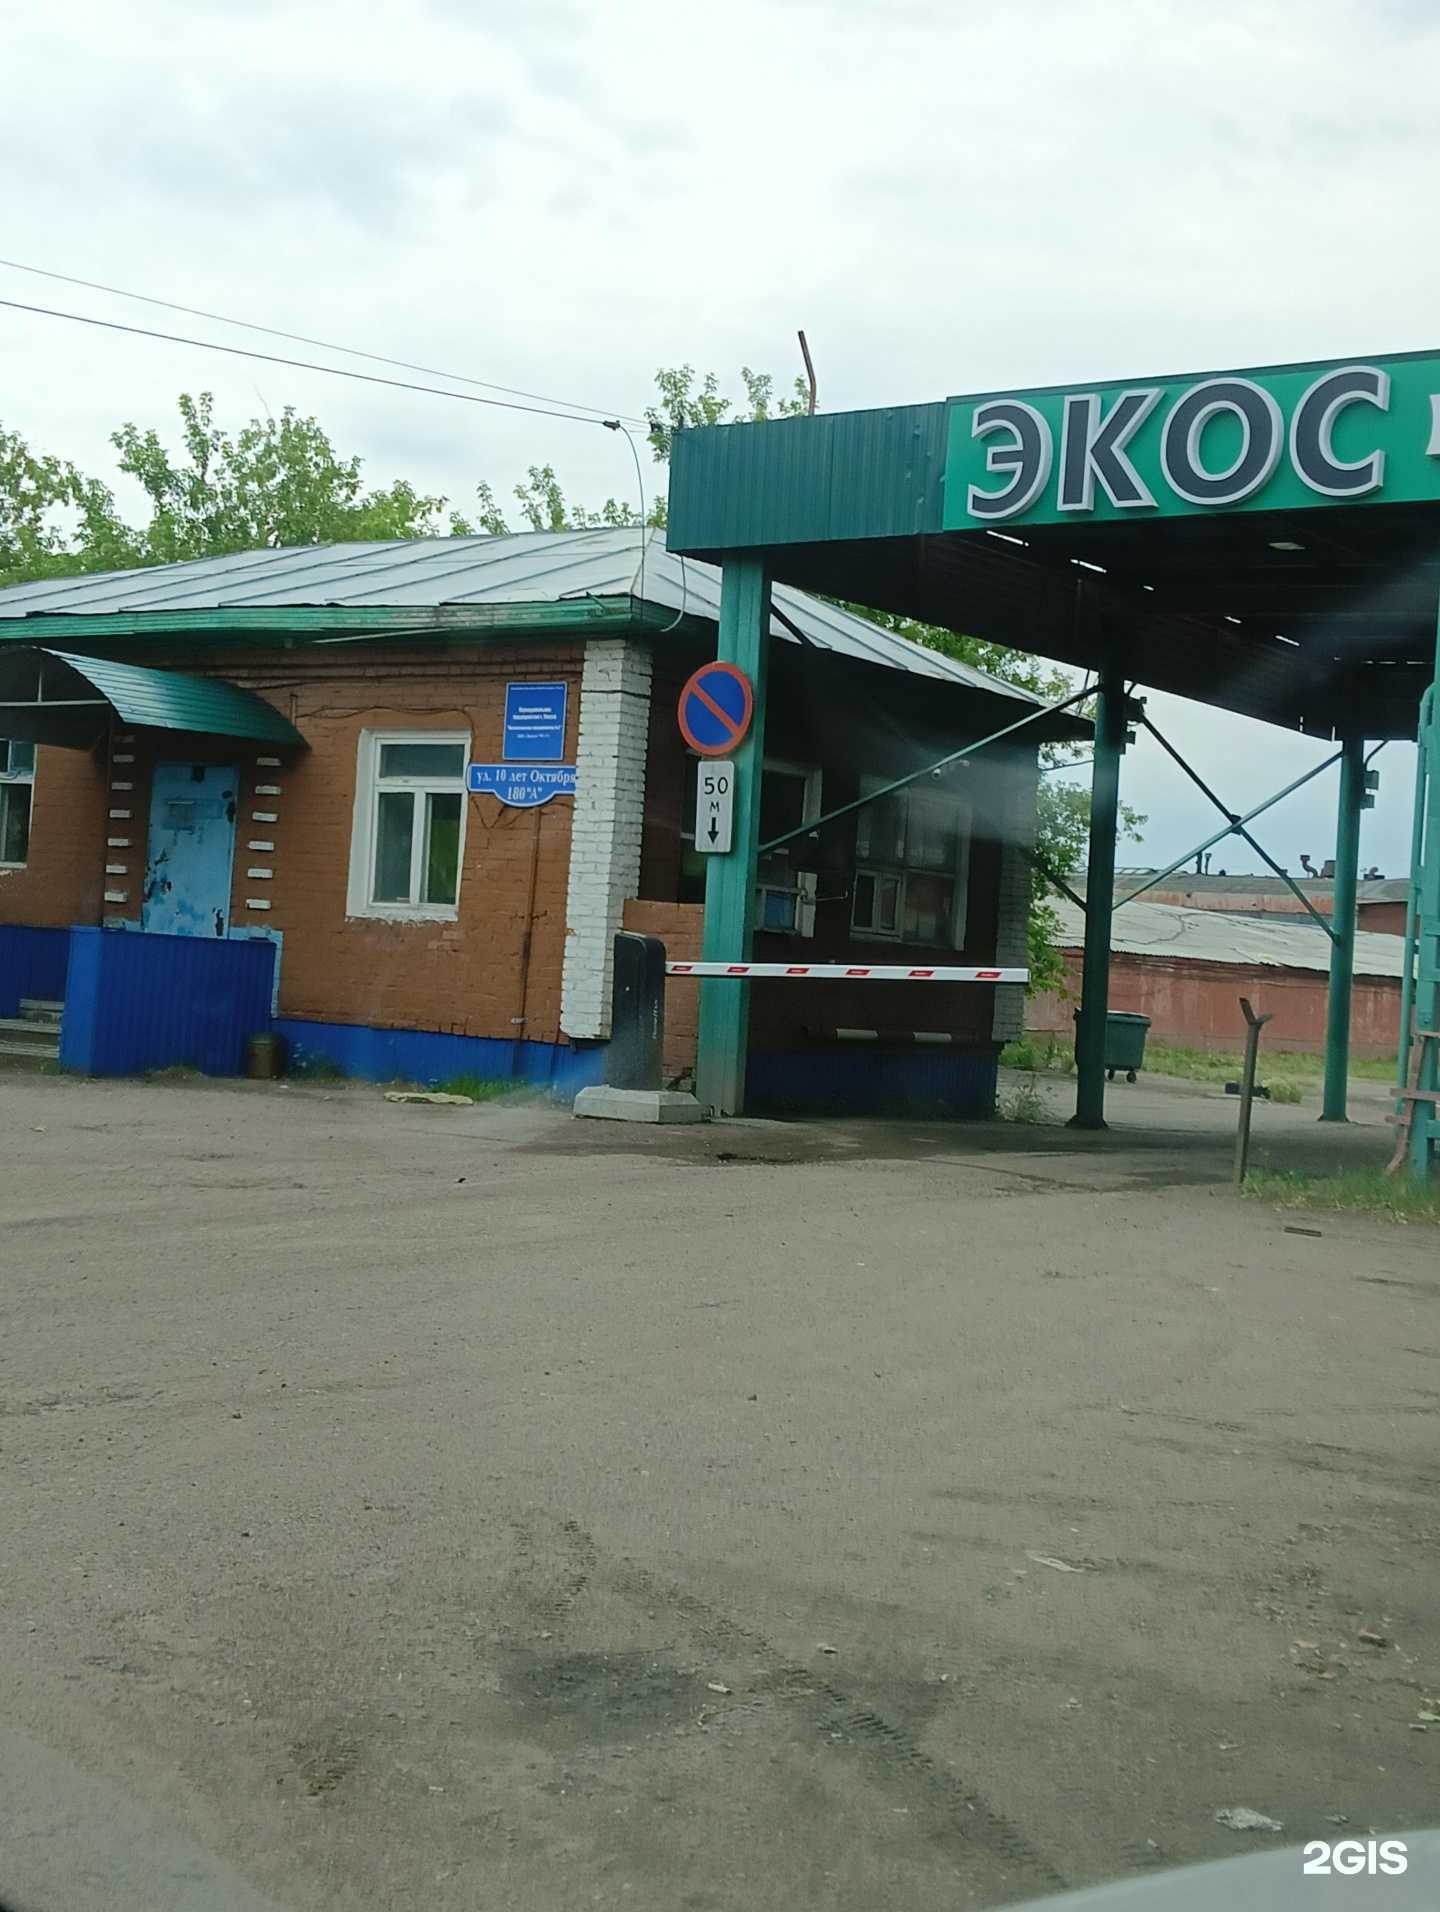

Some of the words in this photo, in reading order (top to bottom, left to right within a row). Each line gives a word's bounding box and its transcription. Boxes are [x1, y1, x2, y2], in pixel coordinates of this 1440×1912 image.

[967, 366, 1391, 519] ЭКОС
[477, 772, 491, 784] ул.
[496, 769, 506, 781] 10
[510, 772, 527, 782] лет
[704, 777, 728, 795] 50
